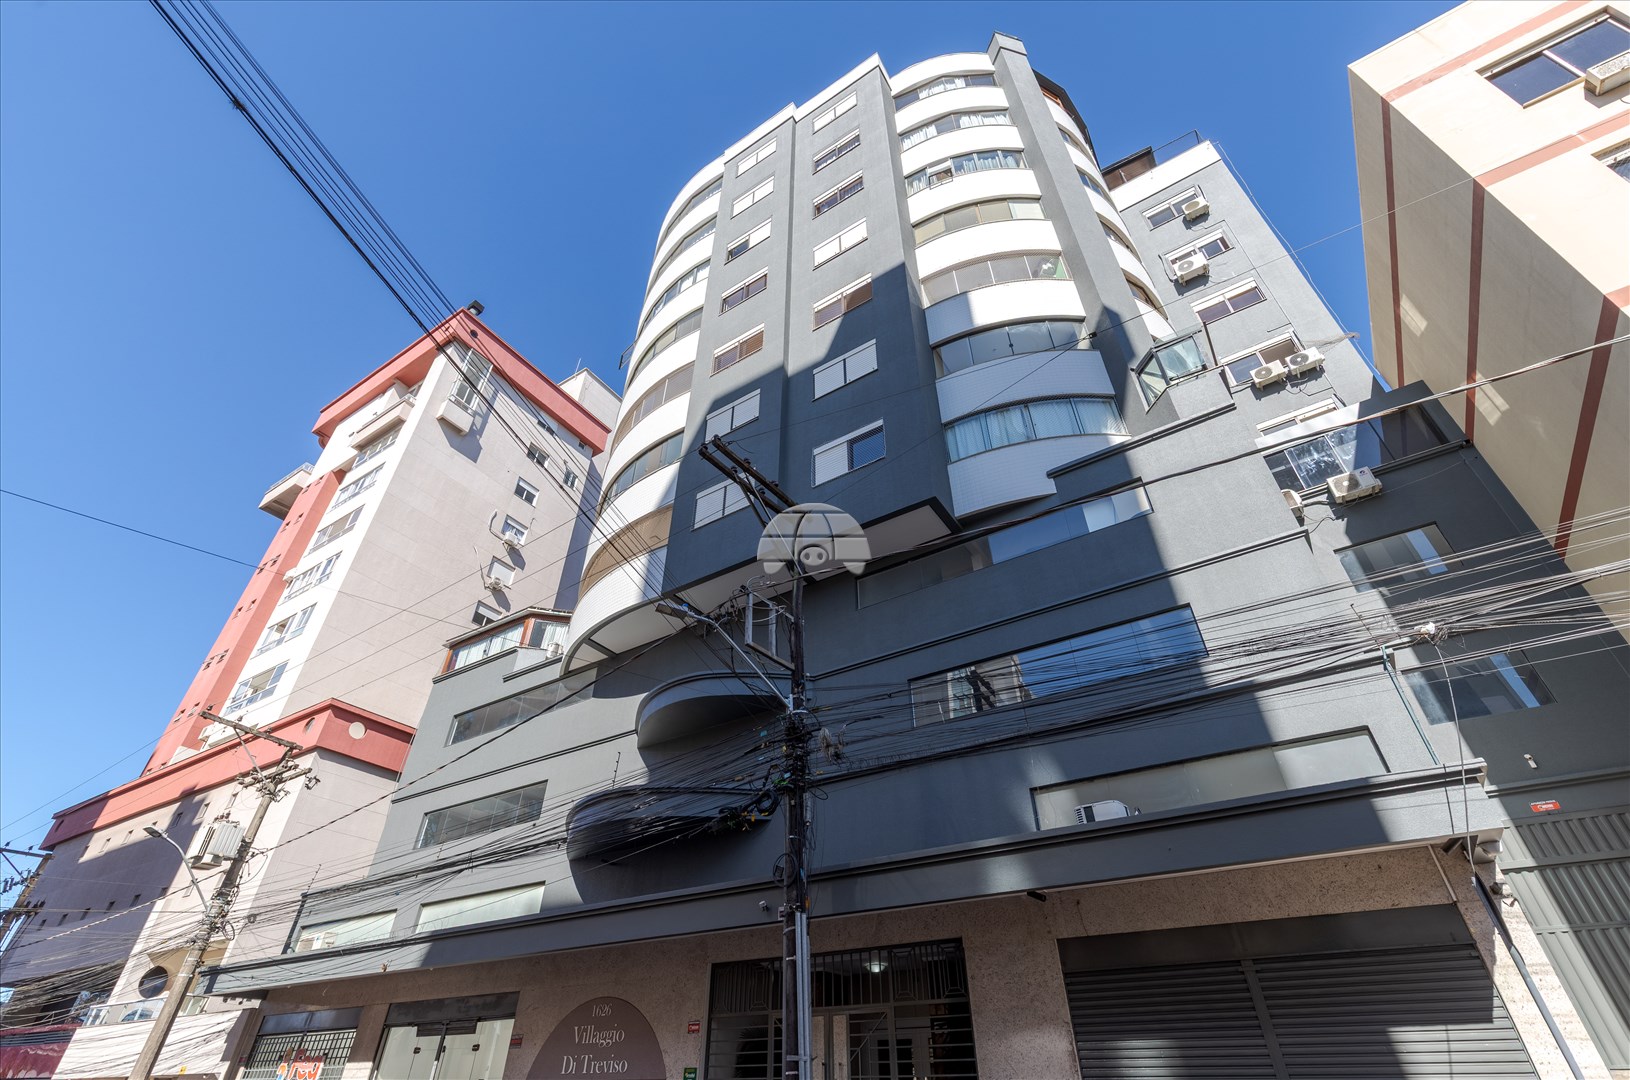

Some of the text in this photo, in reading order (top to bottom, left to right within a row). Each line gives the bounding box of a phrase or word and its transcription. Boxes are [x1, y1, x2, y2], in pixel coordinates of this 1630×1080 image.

[592, 1003, 613, 1017] 1626
[574, 1023, 625, 1048] Villaggio
[560, 1054, 628, 1075] Di Treviso
